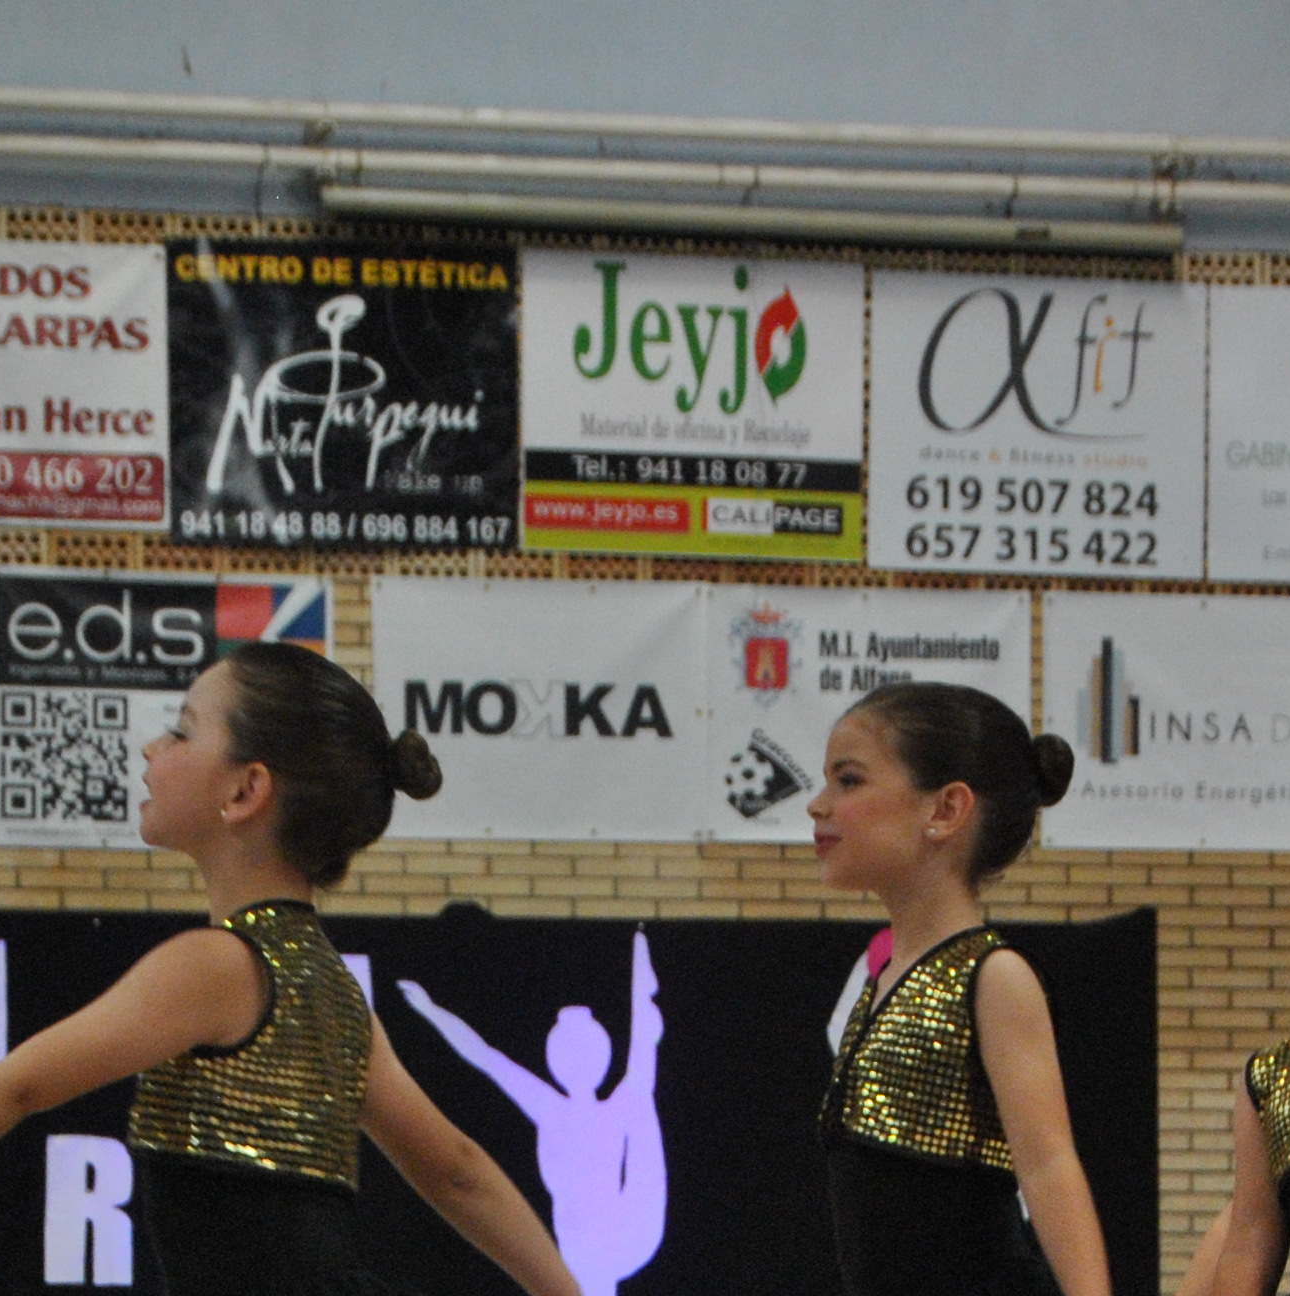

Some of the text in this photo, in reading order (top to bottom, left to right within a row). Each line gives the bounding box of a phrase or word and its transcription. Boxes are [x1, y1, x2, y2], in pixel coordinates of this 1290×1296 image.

[175, 253, 509, 291] CENTRO DE ESTÉTICA
[43, 398, 155, 438] Herce
[580, 413, 649, 439] Material
[654, 417, 671, 440] de
[636, 456, 683, 481] 941
[697, 458, 727, 482] 18
[735, 460, 767, 484] 08
[776, 462, 808, 487] 77
[920, 446, 980, 463] dance
[24, 456, 85, 493] 466
[95, 458, 154, 495] 202
[533, 499, 679, 523] www.jeyjo.es
[906, 474, 1158, 517] 619 507 824
[180, 510, 510, 544] 941 18 48 88 / 696 884 167
[906, 523, 1157, 565] 657 315 422
[8, 588, 205, 666] e.d.s
[818, 629, 1001, 663] M.I. Ayuntamiento
[818, 664, 842, 691] de
[1148, 711, 1253, 743] INSA
